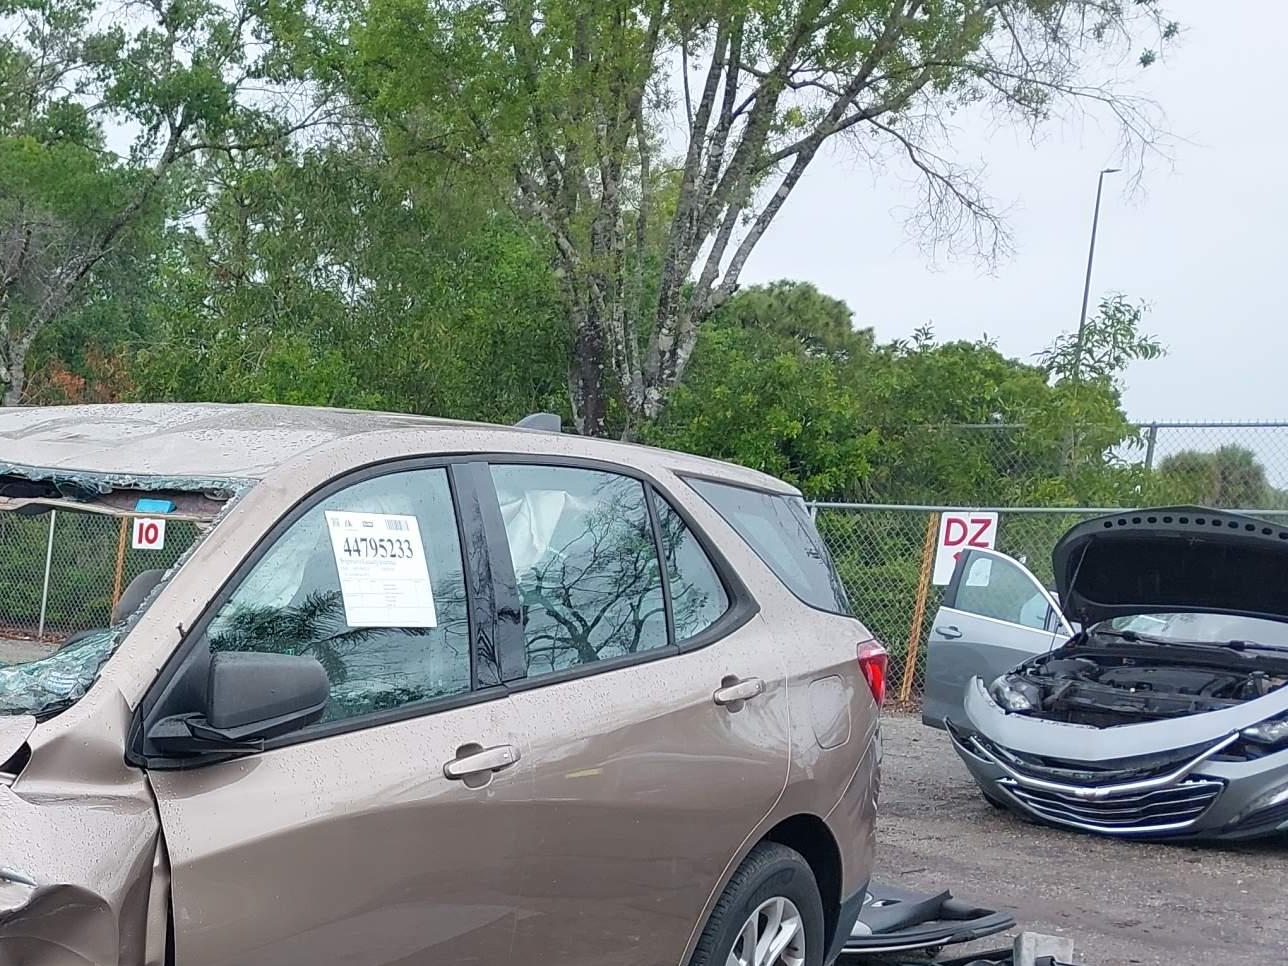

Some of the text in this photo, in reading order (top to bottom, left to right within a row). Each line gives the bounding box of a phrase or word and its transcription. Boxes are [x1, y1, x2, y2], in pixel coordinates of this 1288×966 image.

[137, 522, 159, 545] 10
[943, 518, 993, 548] DZ
[343, 537, 414, 559] 44795233
